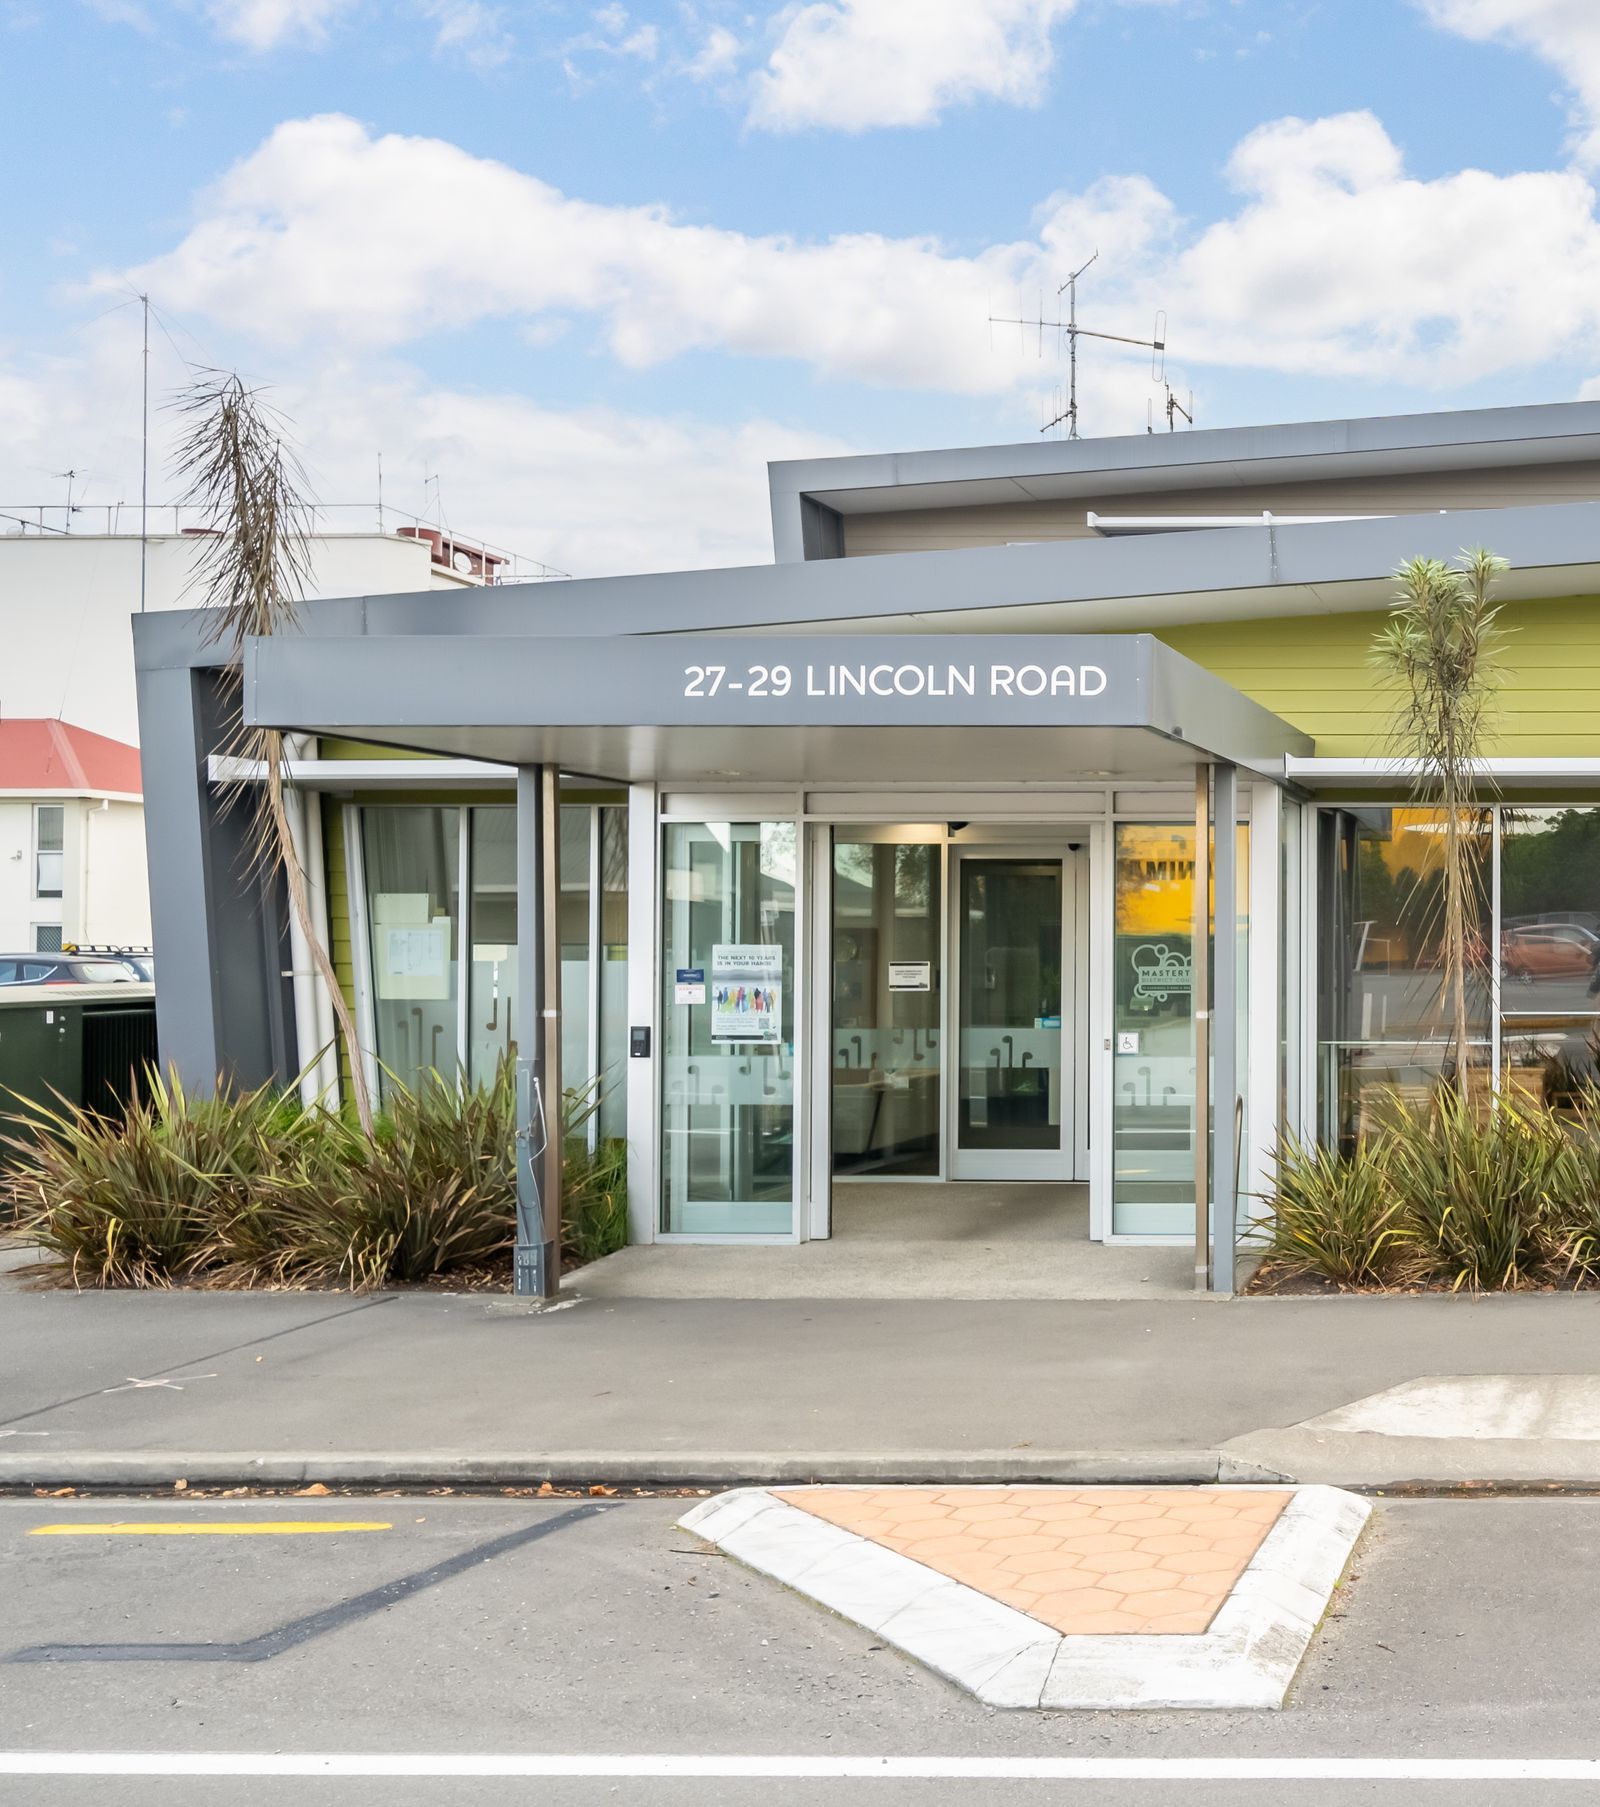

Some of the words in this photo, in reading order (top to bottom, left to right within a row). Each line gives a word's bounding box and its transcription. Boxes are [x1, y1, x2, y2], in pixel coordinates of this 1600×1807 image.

[683, 665, 792, 697] 27-29
[806, 664, 975, 696] LINCOLN
[989, 664, 1108, 696] ROAD
